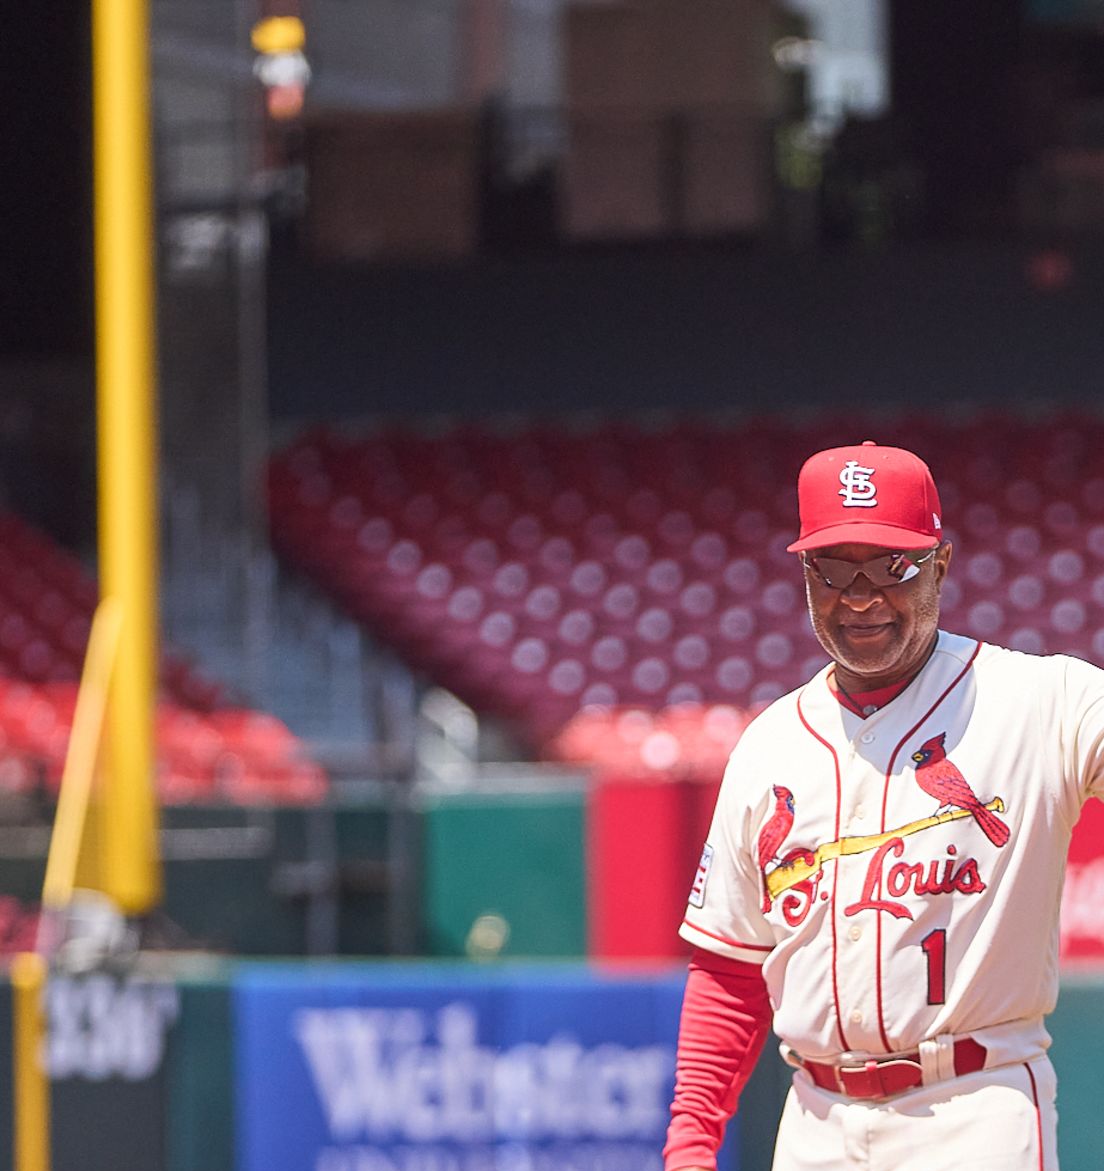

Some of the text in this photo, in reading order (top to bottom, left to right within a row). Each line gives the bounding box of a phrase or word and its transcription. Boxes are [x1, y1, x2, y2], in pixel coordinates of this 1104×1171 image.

[844, 837, 987, 922] Louis
[921, 929, 947, 1006] 1
[299, 1004, 668, 1139] Webster
